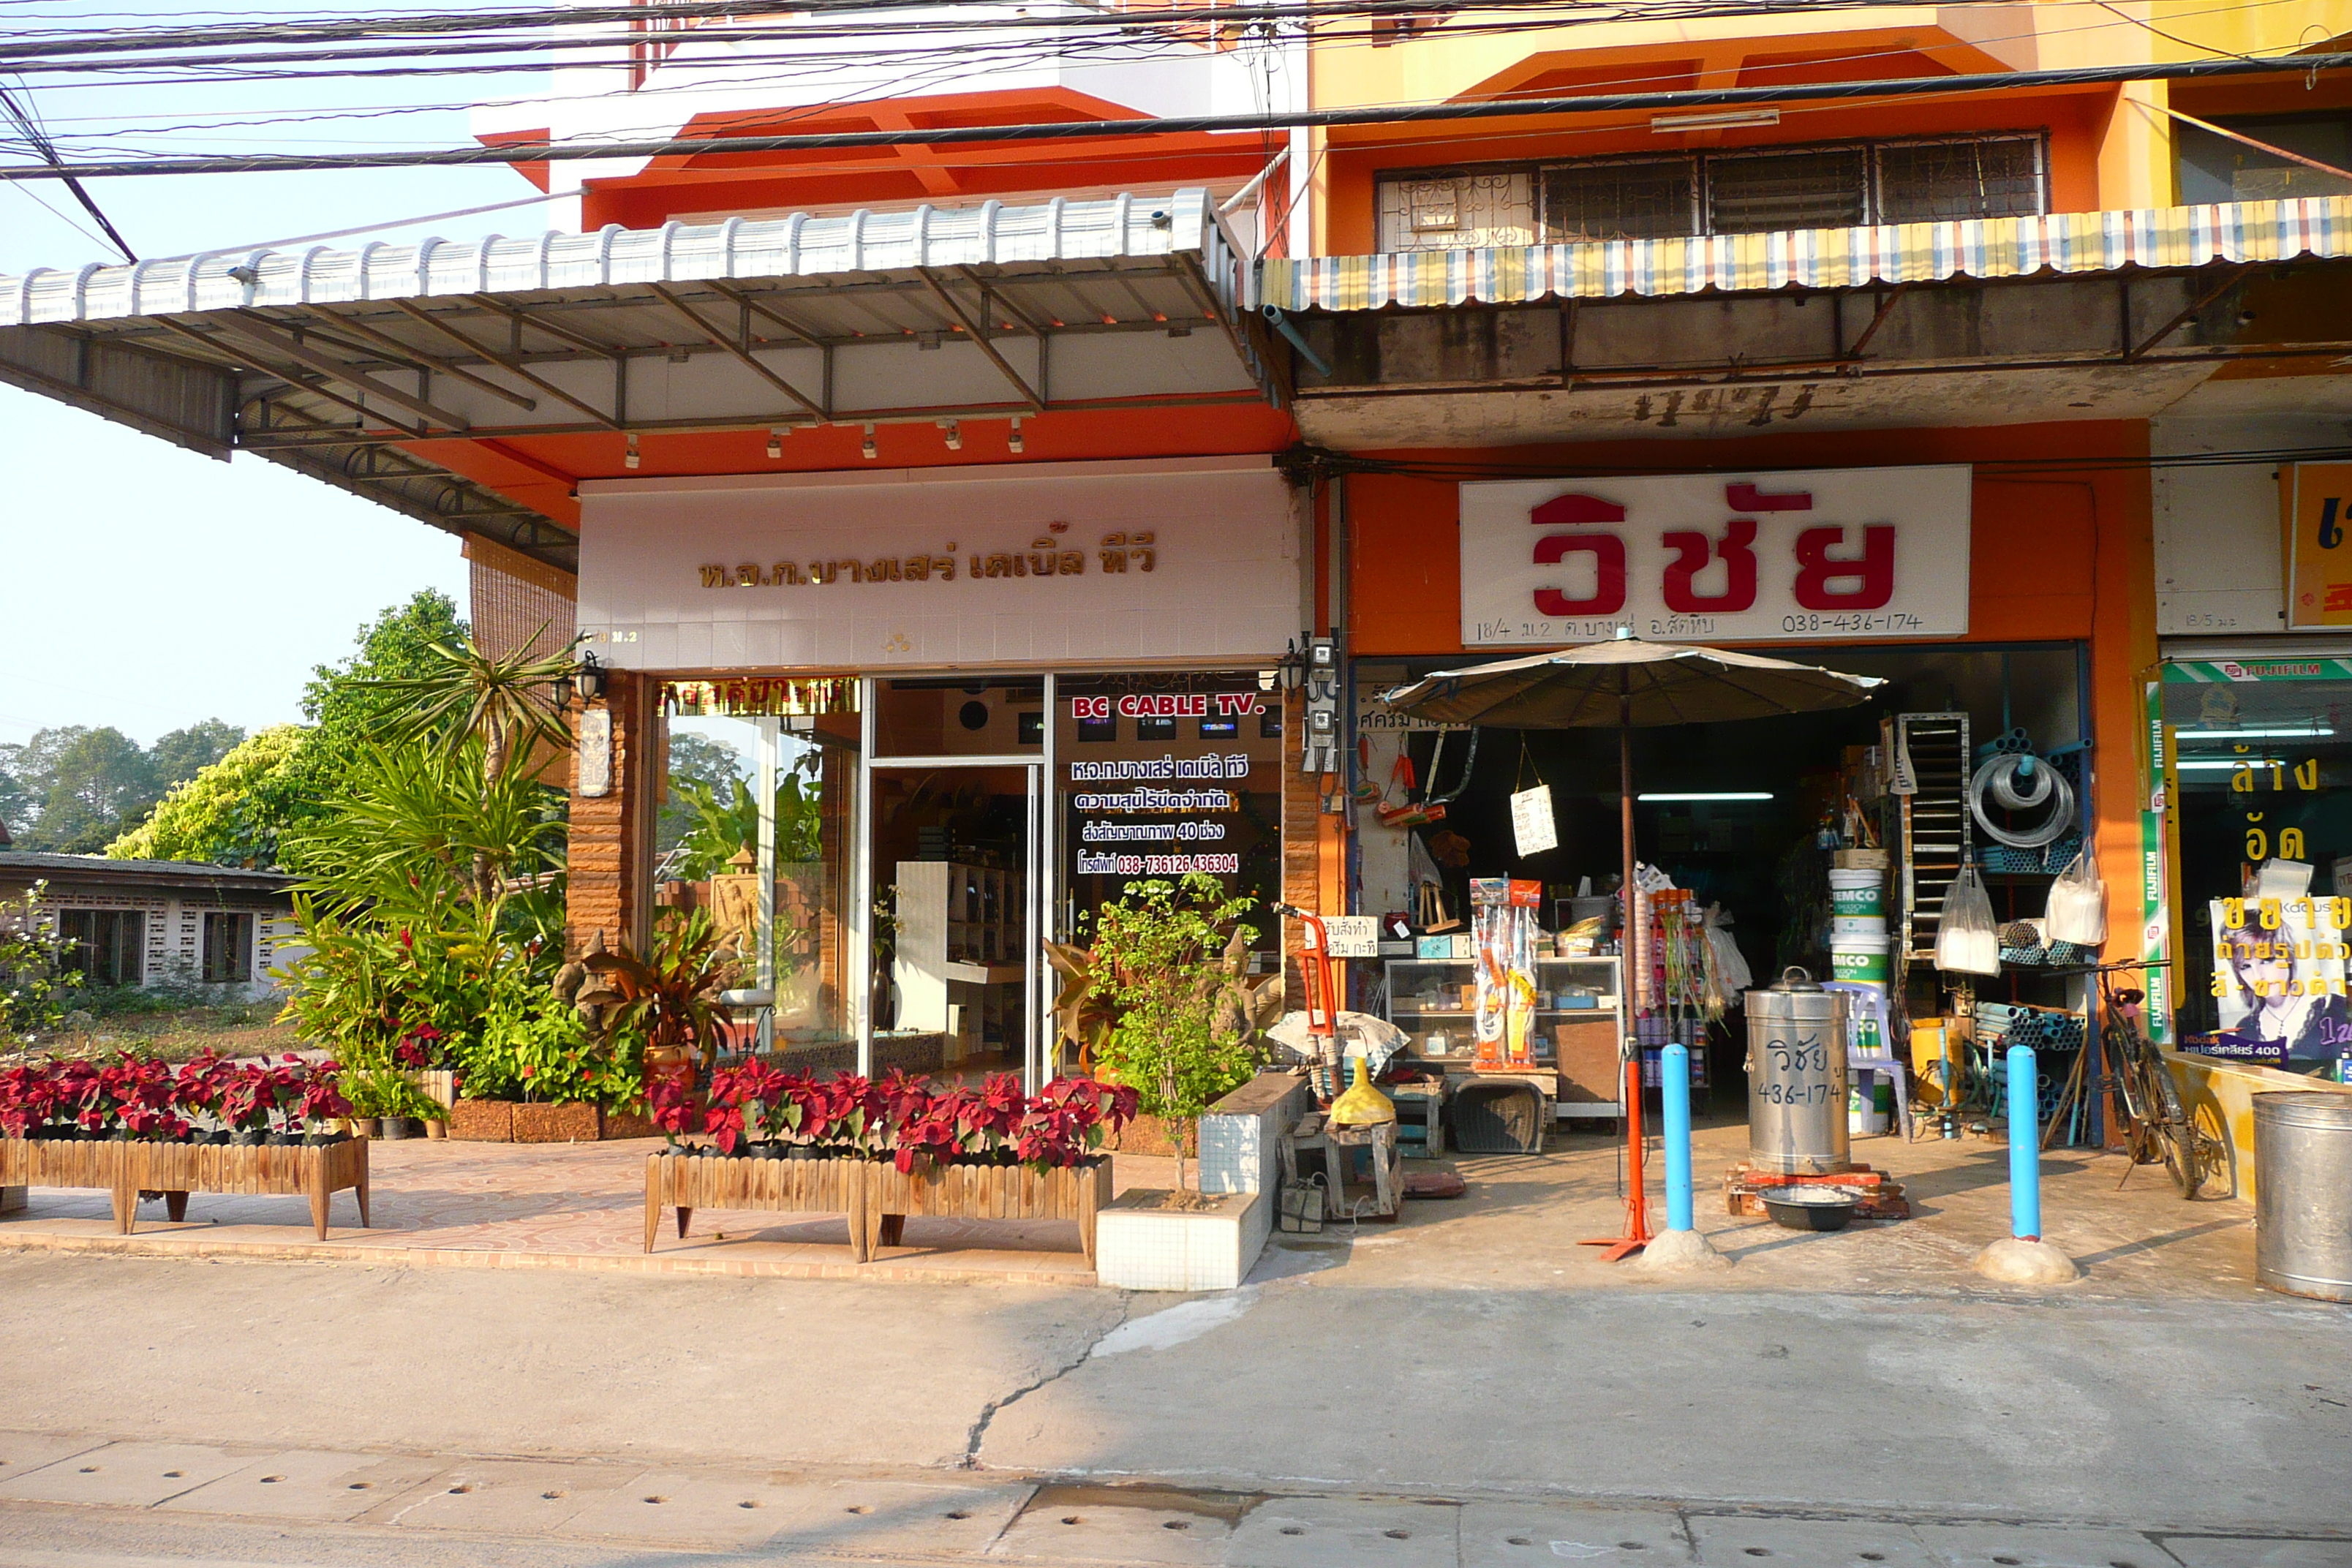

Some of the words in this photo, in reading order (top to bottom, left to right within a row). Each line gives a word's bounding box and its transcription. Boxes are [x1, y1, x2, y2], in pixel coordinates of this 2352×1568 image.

[970, 521, 1084, 578] เคเบิ้ล
[1098, 532, 1156, 573] ทีวี
[1531, 483, 1896, 617] วิชัย
[1782, 614, 1924, 633] 038-436-174
[2246, 664, 2320, 676] FUJIFILM
[1073, 696, 1109, 718] BC
[1118, 694, 1207, 717] CABLE
[2152, 720, 2163, 768] FUJIFILM
[2232, 744, 2318, 793] ล้าง
[1177, 822, 1198, 840] 40
[1199, 820, 1224, 840] ช่อง
[2246, 811, 2305, 861] อัด
[2146, 851, 2157, 900] FUJIFILM
[2223, 897, 2351, 930] ขยาย
[2151, 977, 2162, 1027] FUJIFILM
[1766, 1033, 1828, 1071] วิชัย
[2255, 1047, 2280, 1055] 400
[1758, 1083, 1842, 1104] 436-174
